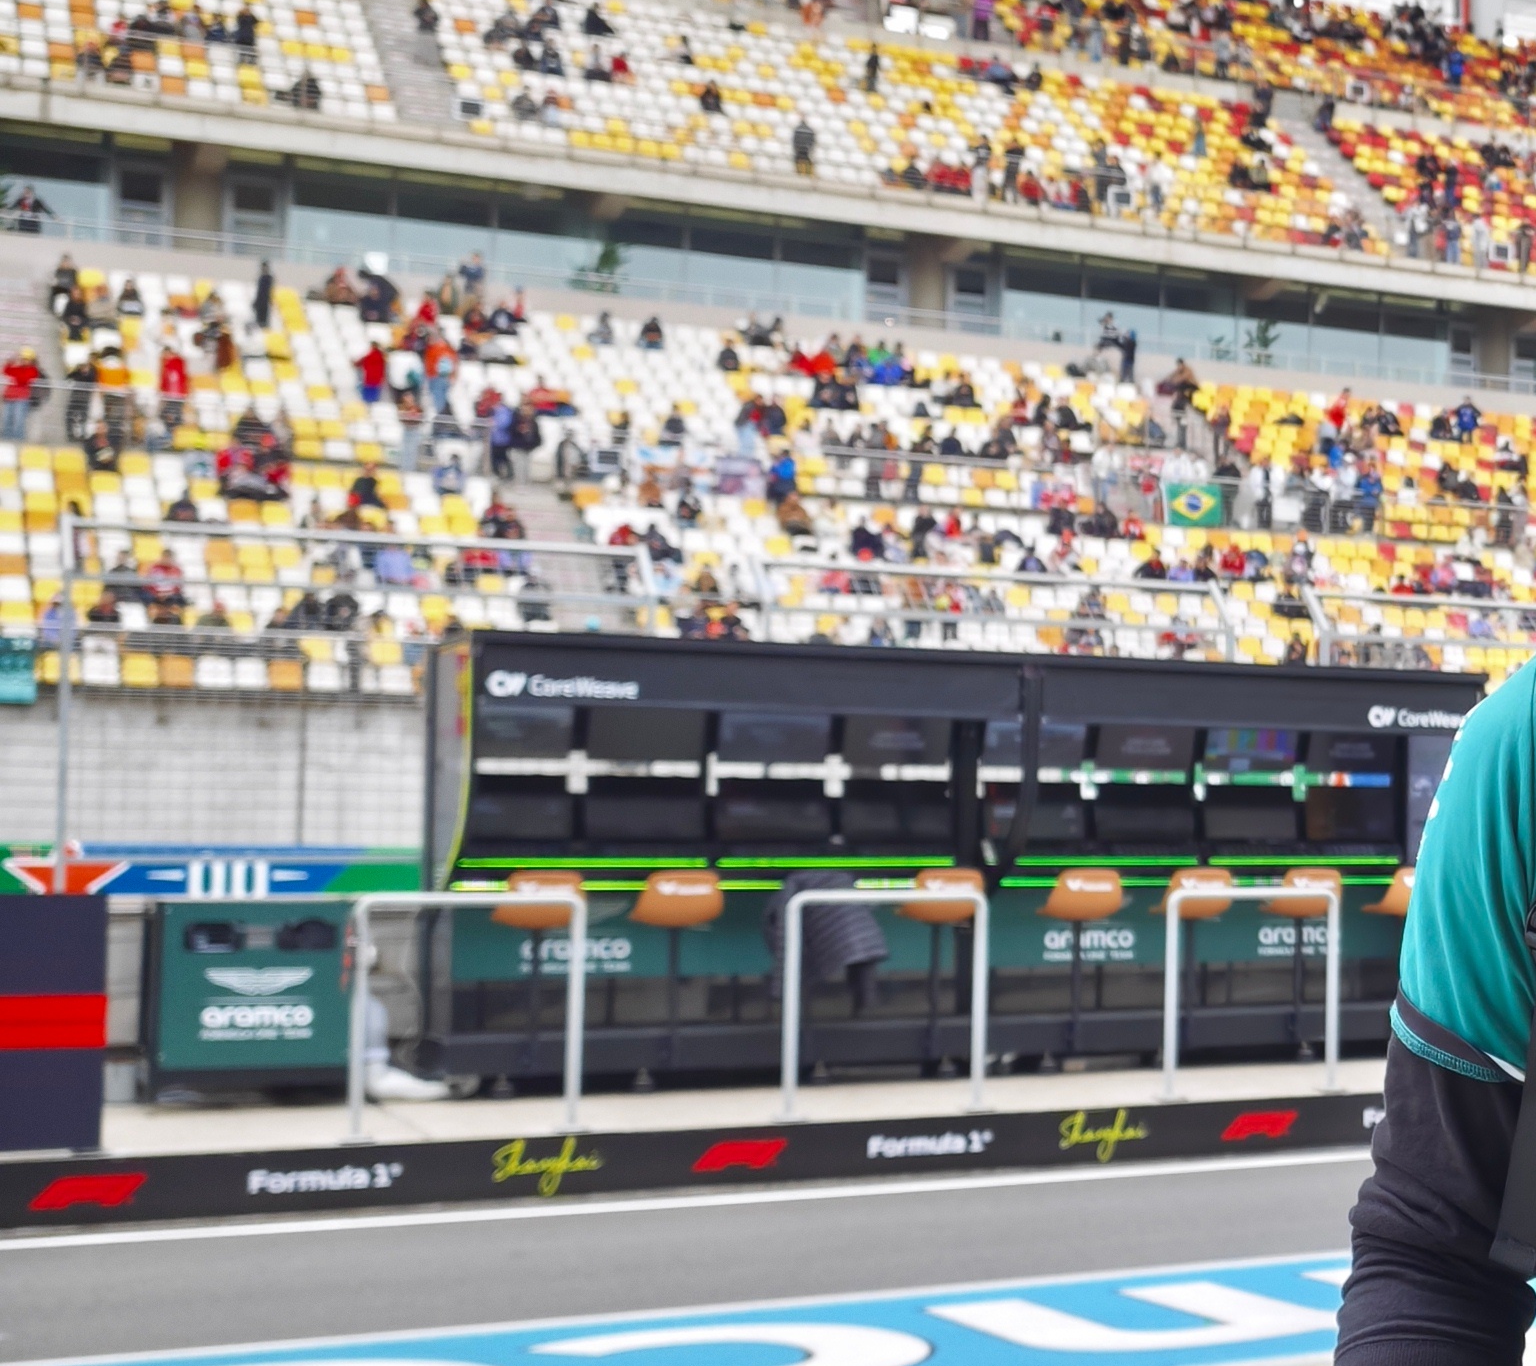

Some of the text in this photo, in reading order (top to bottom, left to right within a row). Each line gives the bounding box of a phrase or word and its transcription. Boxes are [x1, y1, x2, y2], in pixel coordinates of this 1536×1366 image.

[200, 1004, 314, 1028] aramco
[866, 1131, 966, 1159] Formula
[247, 1165, 370, 1195] Formula
